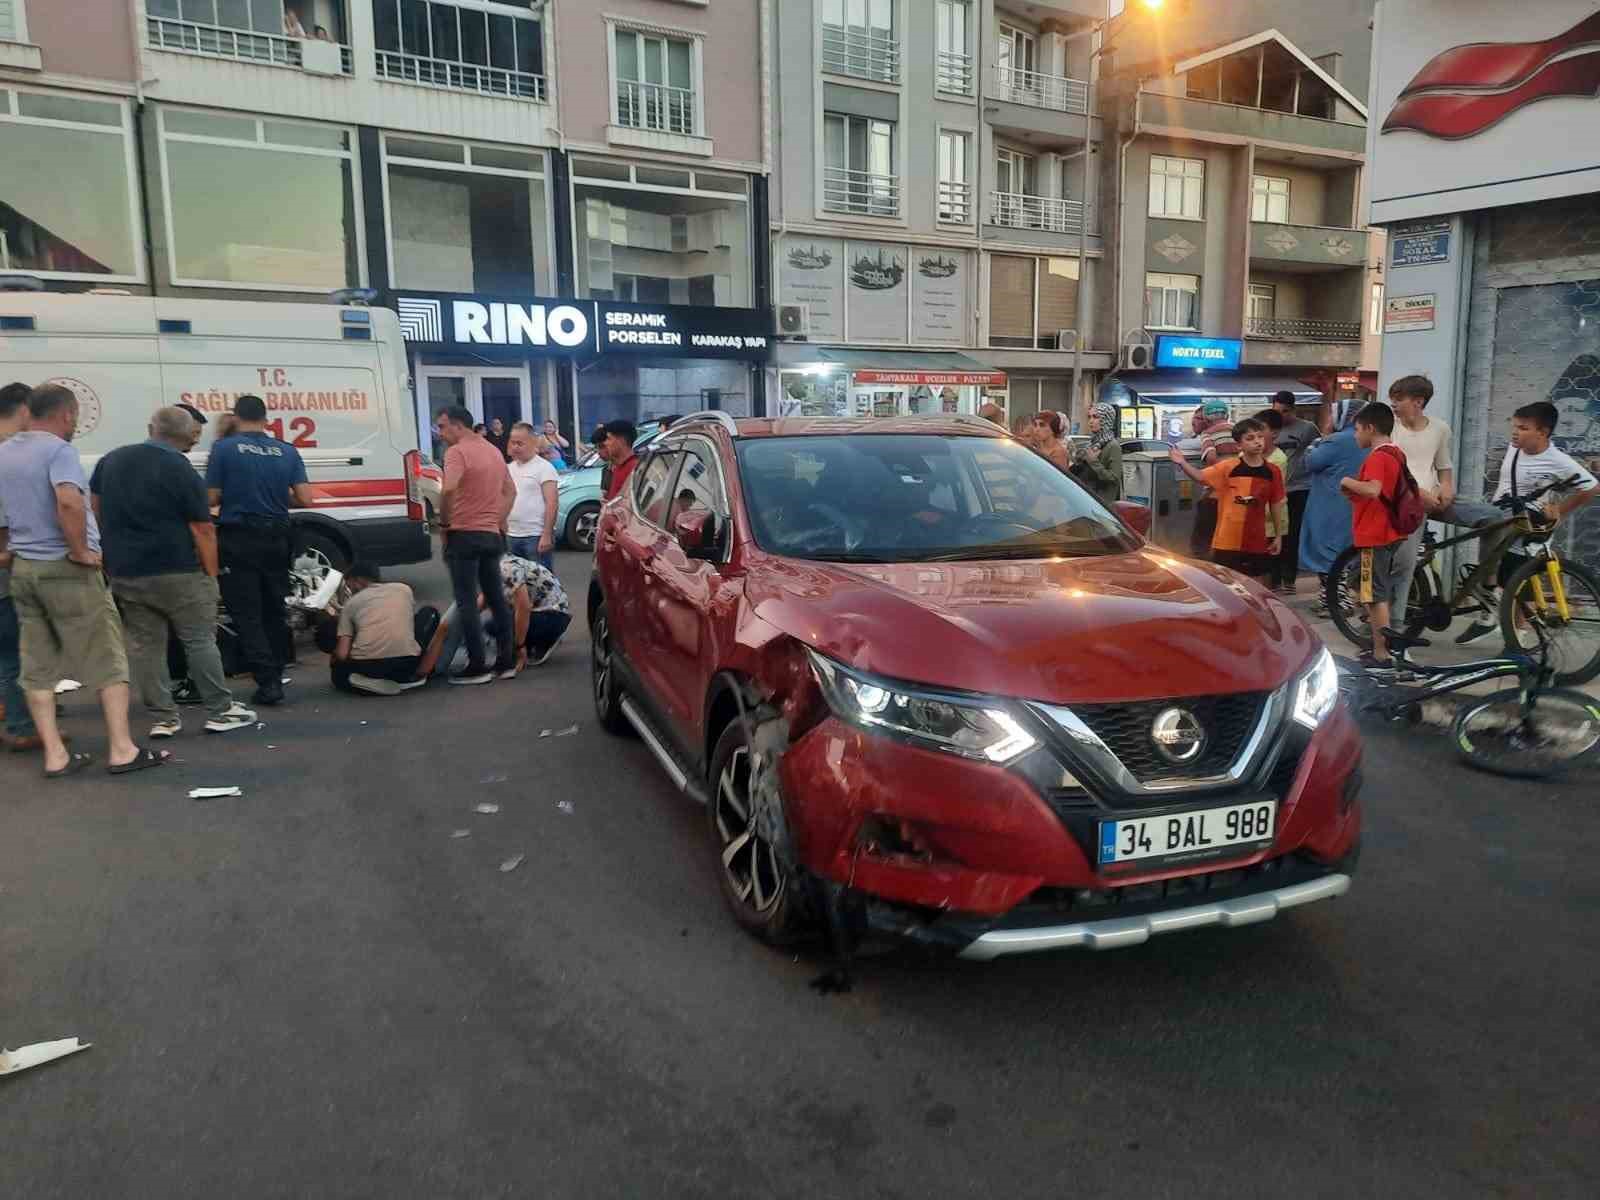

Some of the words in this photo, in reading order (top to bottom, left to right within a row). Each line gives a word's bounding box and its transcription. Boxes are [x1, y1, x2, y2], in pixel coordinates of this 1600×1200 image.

[452, 300, 588, 346] RINO
[608, 330, 681, 345] PORSELEN
[257, 368, 293, 387] T.C.
[180, 387, 253, 412] SAĞL
[266, 389, 368, 410] BAKANLIĞI
[264, 416, 318, 448] 12
[1121, 823, 1152, 855] 34
[1167, 815, 1211, 850] BAL
[1225, 806, 1270, 840] 988
